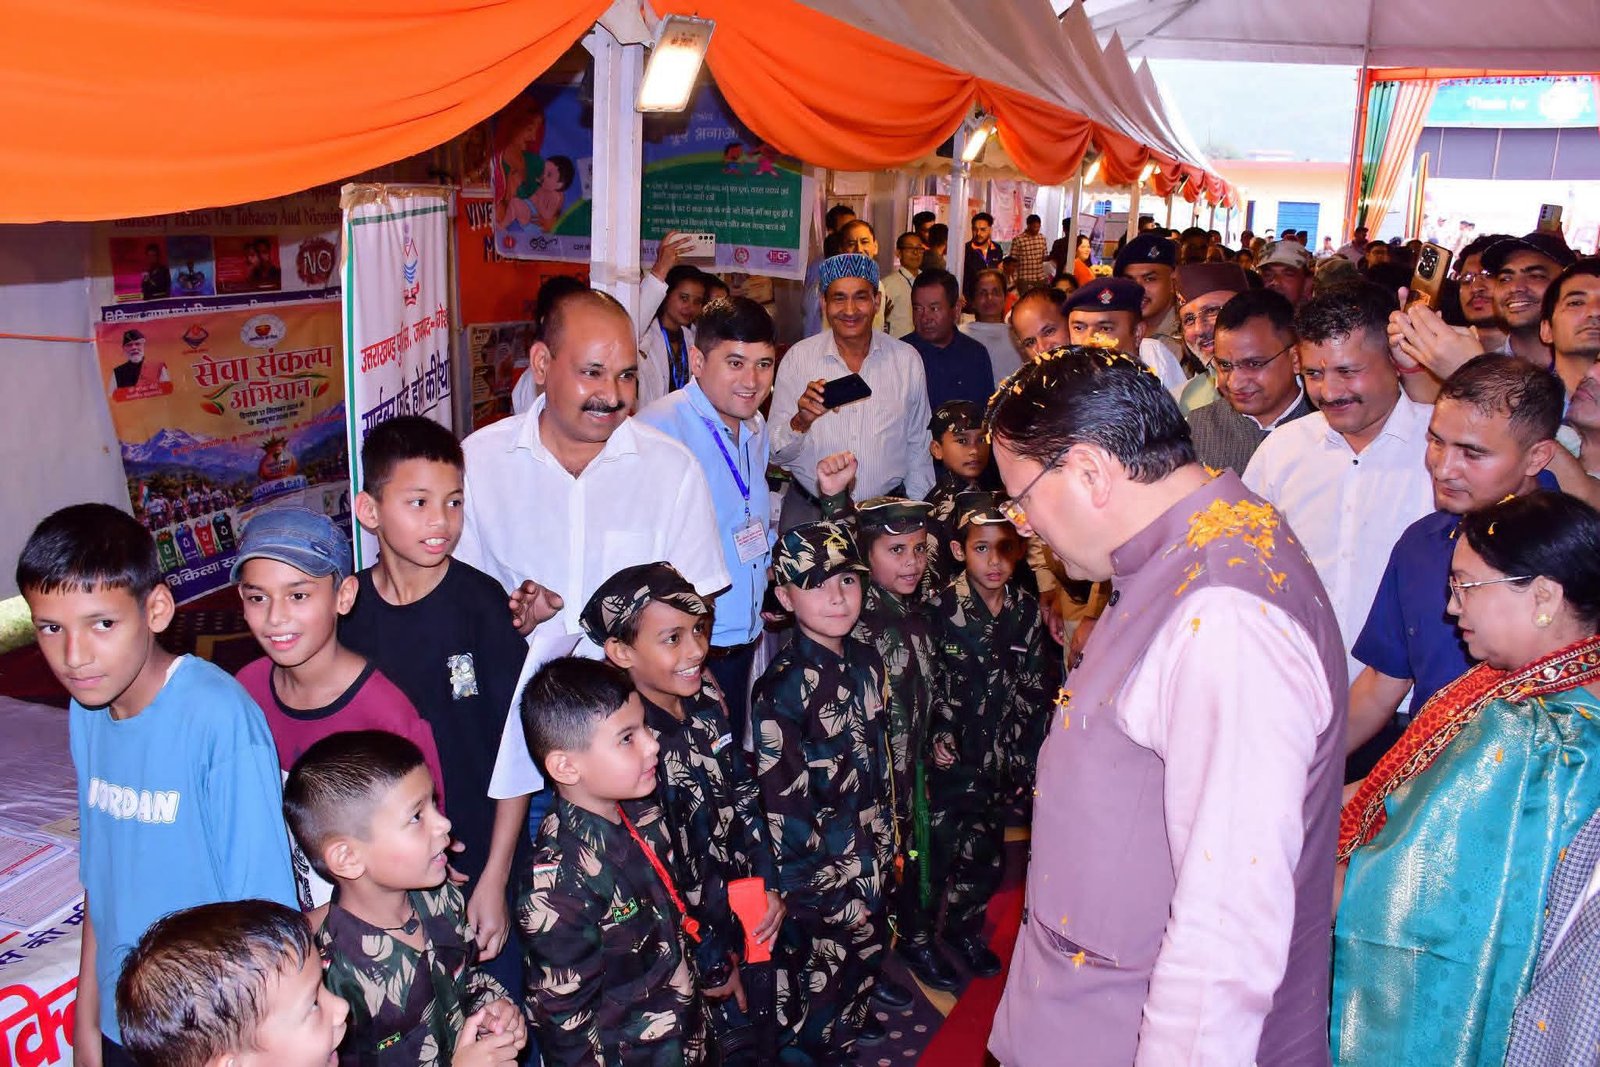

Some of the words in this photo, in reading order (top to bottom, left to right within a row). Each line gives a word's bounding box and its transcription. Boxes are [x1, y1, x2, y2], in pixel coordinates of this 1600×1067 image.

[303, 249, 332, 275] NO
[192, 355, 249, 387] सेवा
[254, 347, 335, 378] संकल्प
[230, 378, 311, 409] अभियान
[165, 560, 221, 588] चिकित्सा
